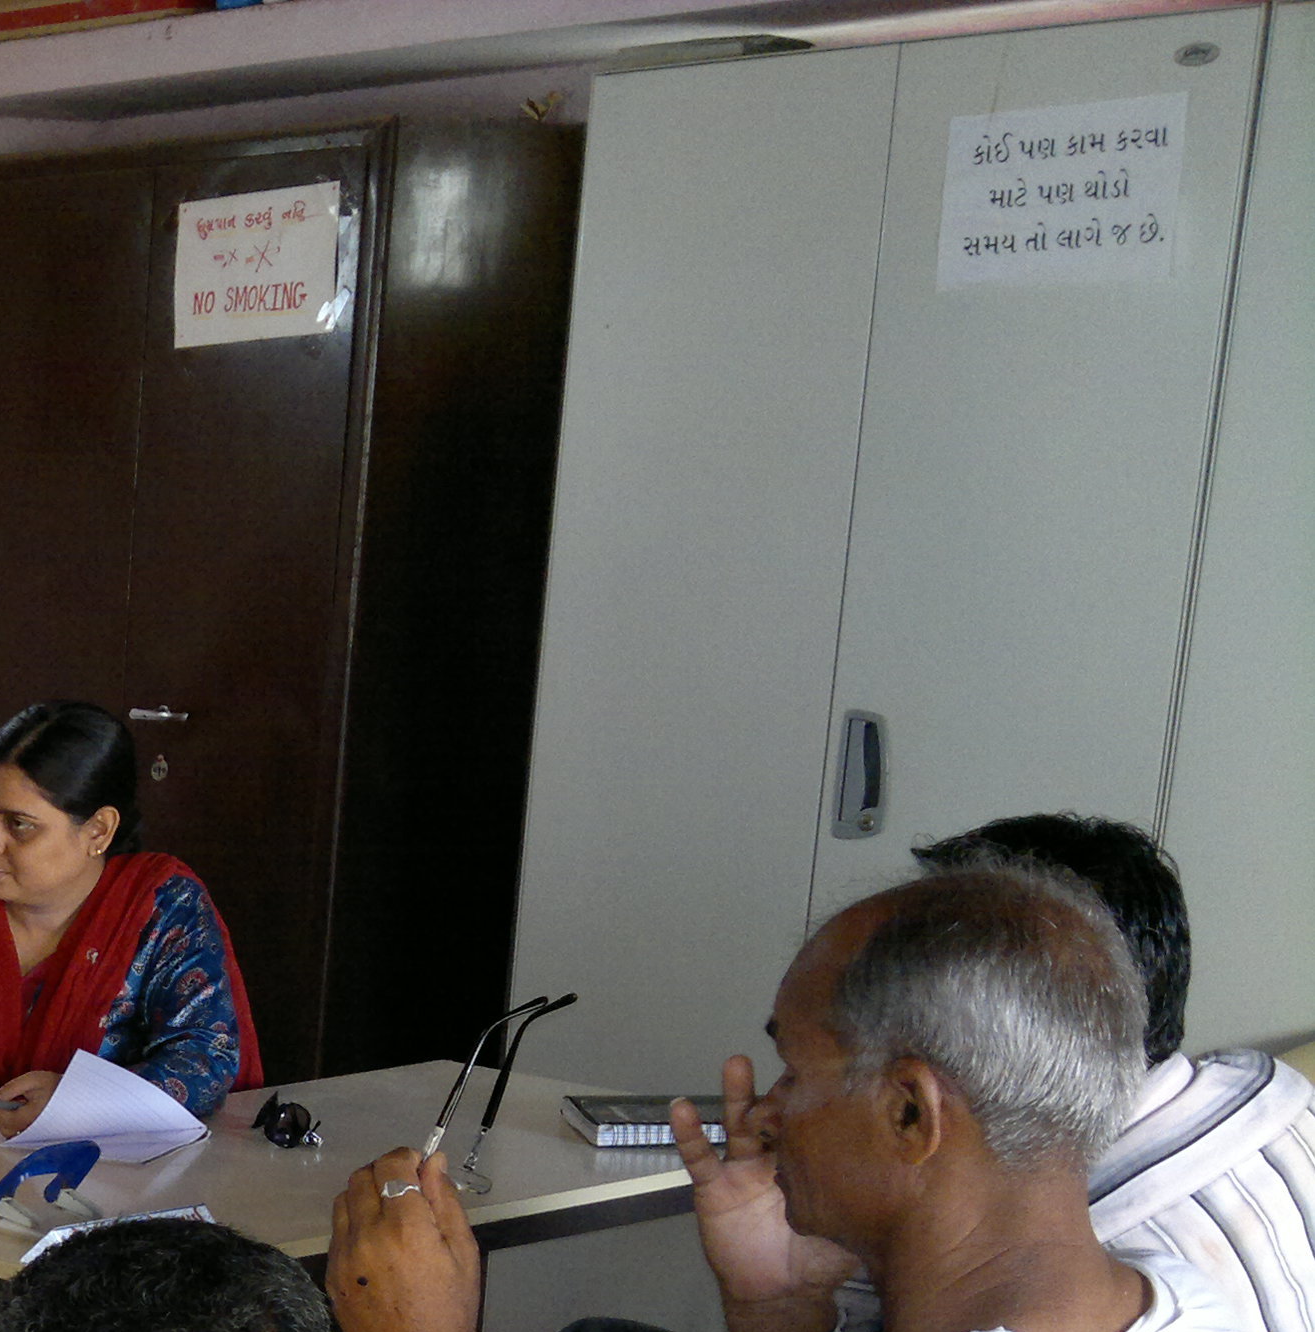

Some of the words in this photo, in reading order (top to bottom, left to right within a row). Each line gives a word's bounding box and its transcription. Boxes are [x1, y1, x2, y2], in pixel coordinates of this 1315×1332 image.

[972, 132, 1014, 165] કોઈ
[1019, 137, 1057, 160] પણ
[1067, 132, 1106, 157] કામ
[1117, 126, 1168, 152] કરવા
[990, 177, 1028, 209] માટે
[1038, 183, 1075, 205] પણ
[1084, 168, 1130, 201] થોડો
[963, 234, 1018, 257] સમય
[1025, 221, 1048, 252] તો
[1056, 217, 1103, 250] લાગે
[1111, 222, 1133, 246] જ
[1138, 212, 1165, 244] છે.
[193, 290, 216, 316] NO
[223, 280, 308, 313] SMOKING
